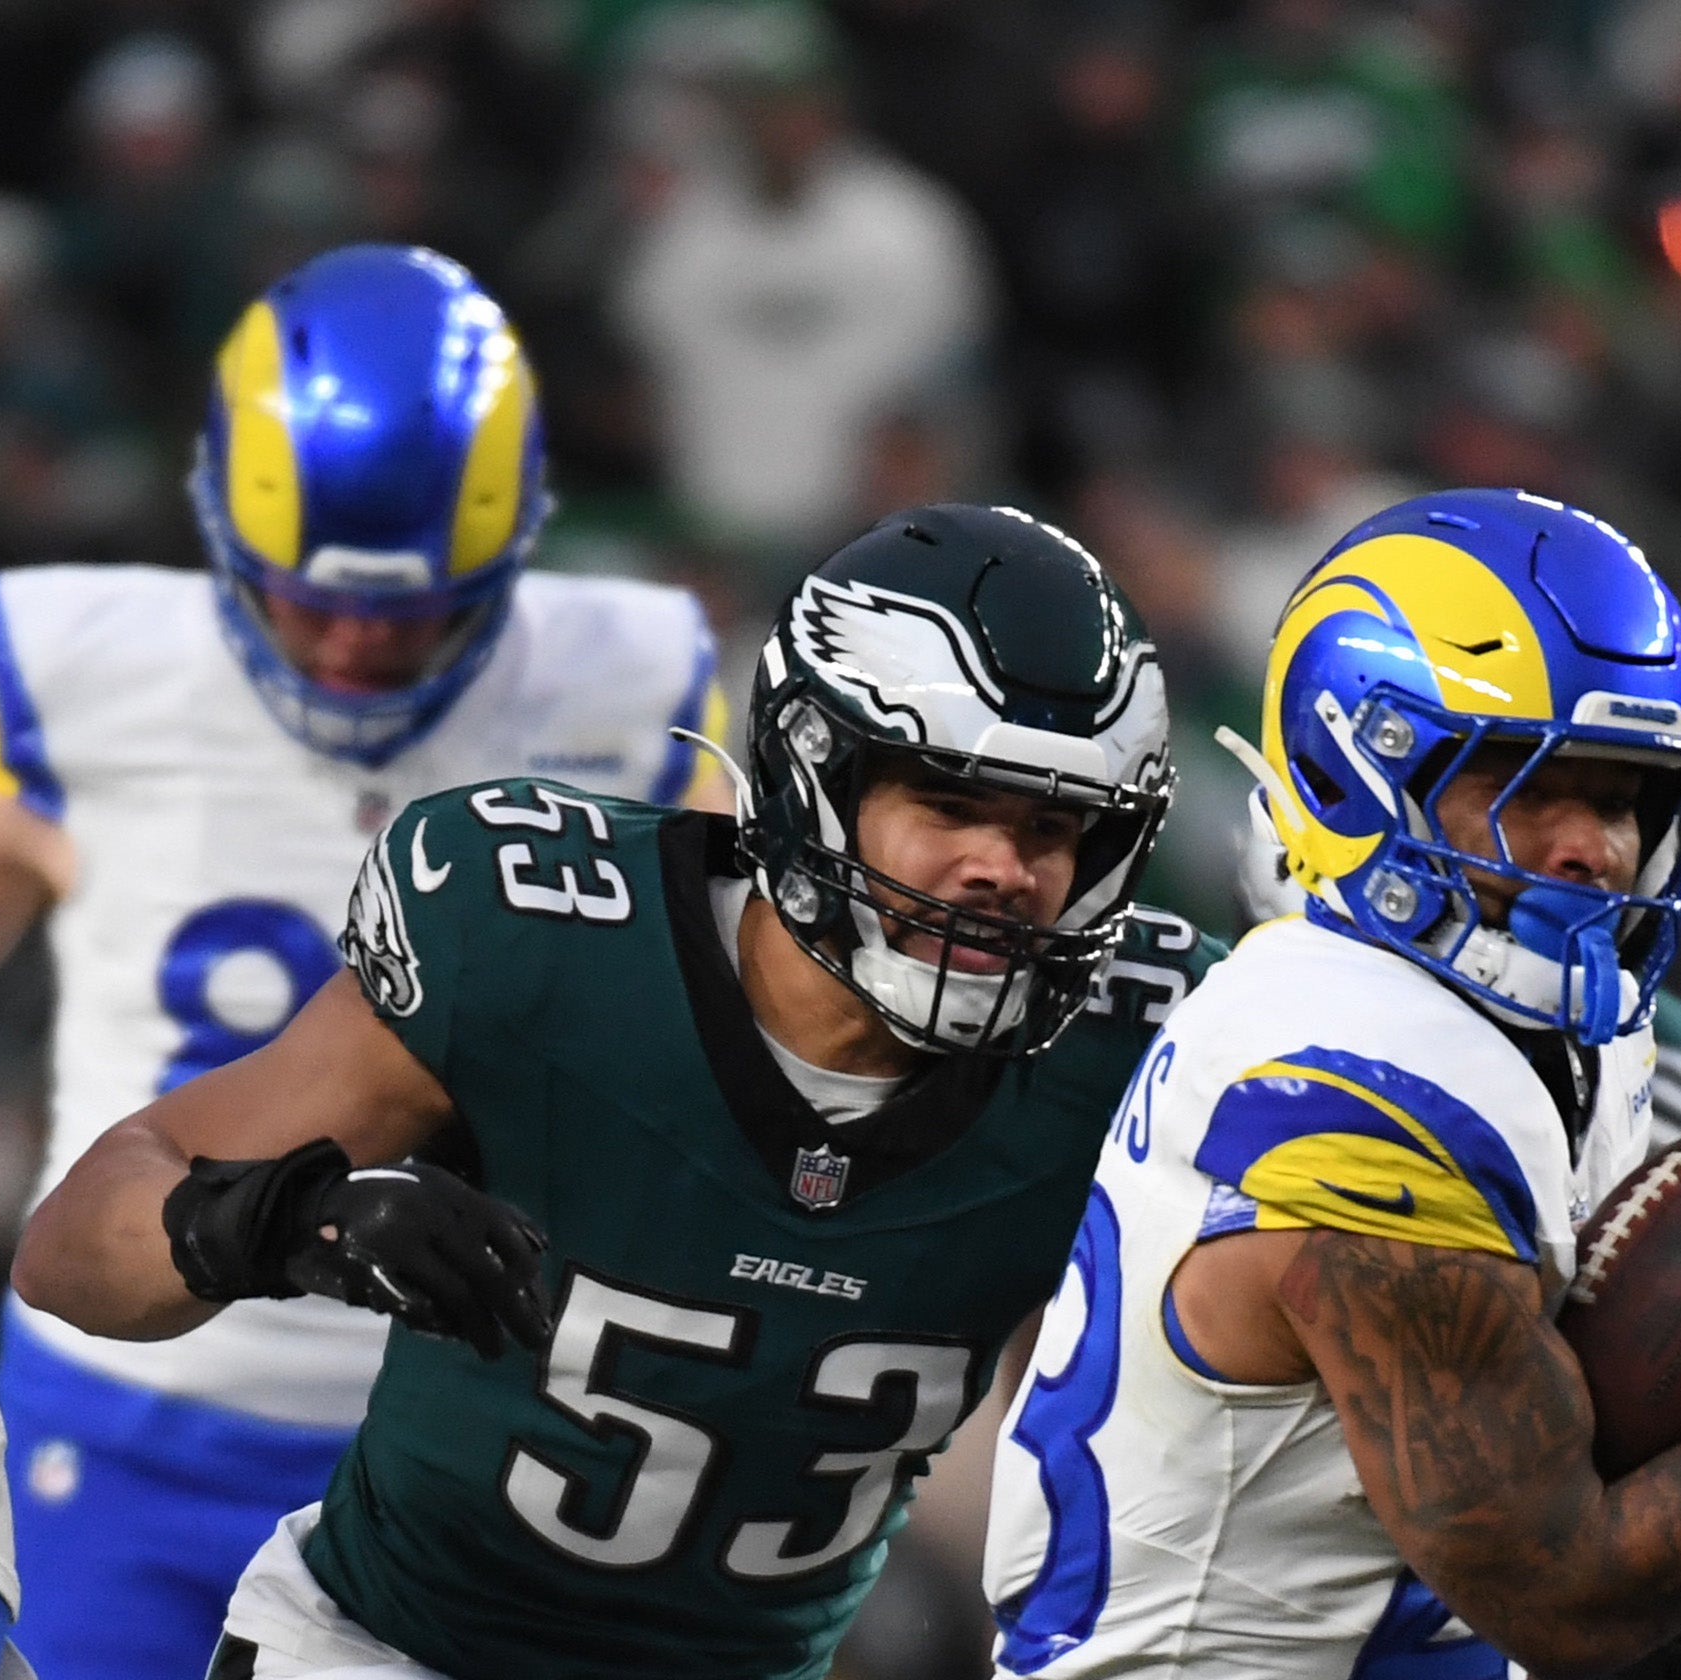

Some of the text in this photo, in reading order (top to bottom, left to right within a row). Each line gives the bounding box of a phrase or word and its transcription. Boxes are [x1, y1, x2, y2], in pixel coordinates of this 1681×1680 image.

[470, 786, 632, 922] 53
[729, 1253, 869, 1300] EAGLES
[506, 1268, 974, 1582] 53
